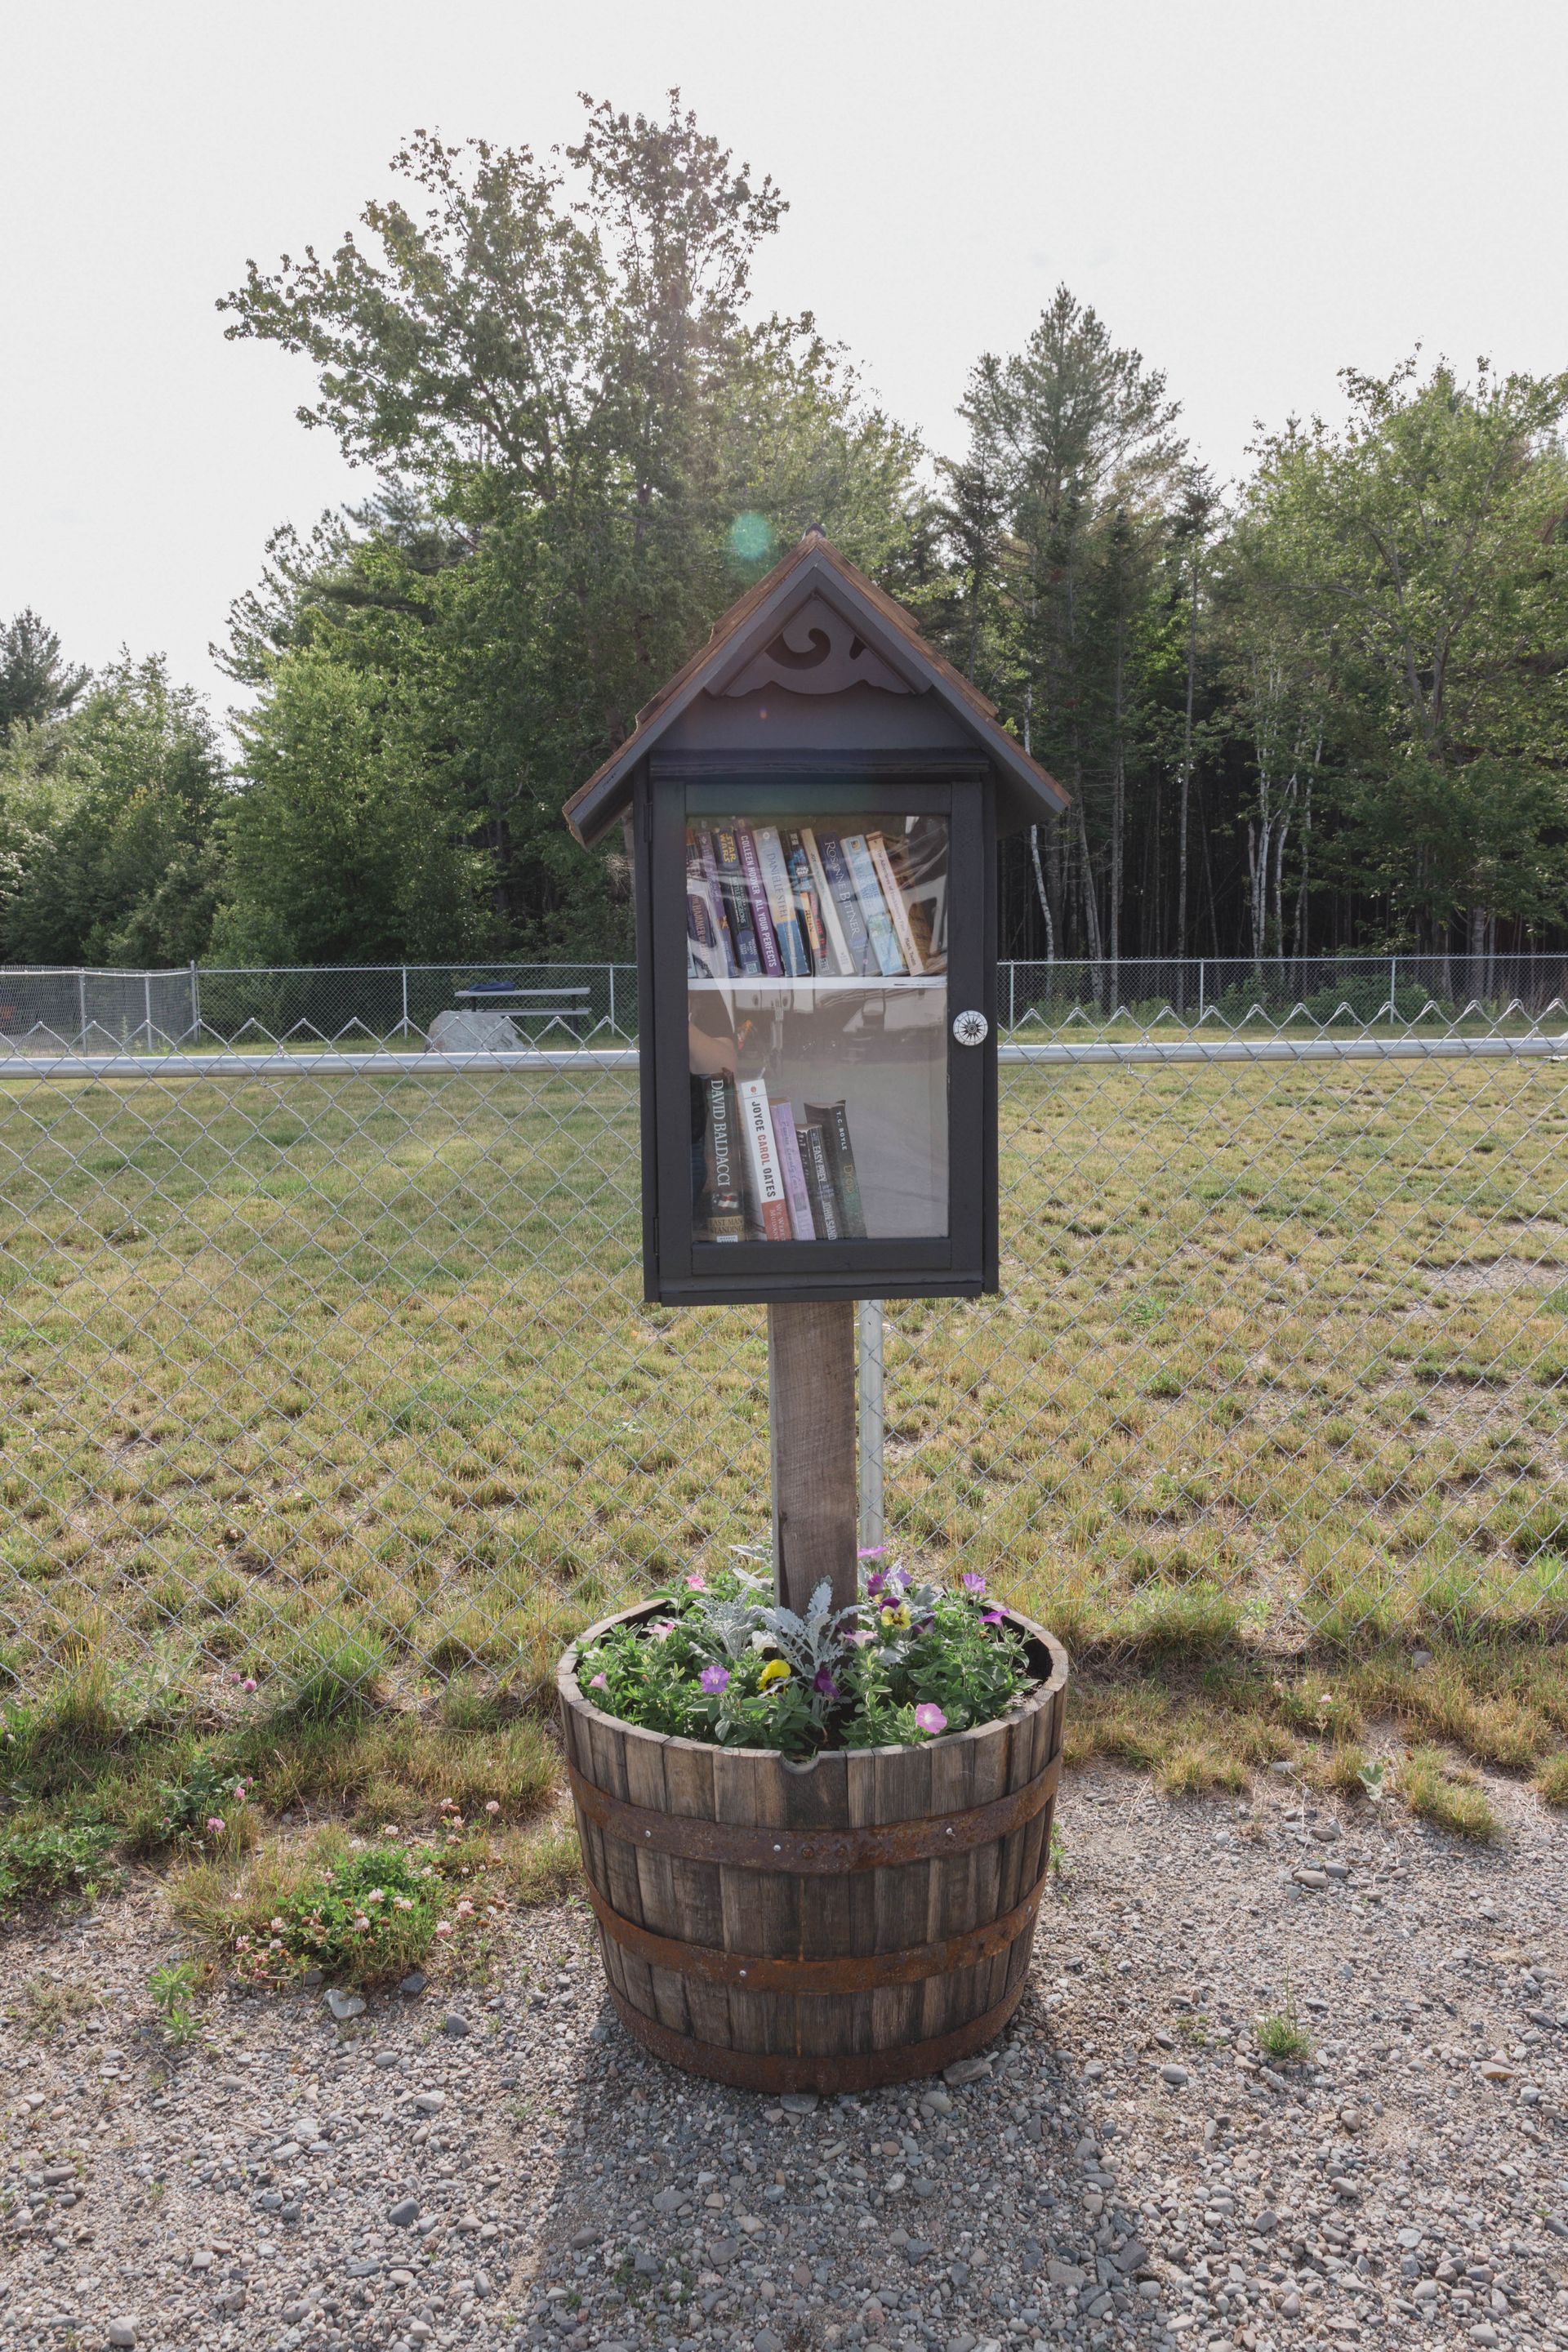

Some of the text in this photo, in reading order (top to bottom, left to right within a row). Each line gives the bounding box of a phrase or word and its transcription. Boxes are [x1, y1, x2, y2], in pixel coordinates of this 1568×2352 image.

[719, 833, 731, 863] WARS
[725, 833, 737, 862] STAR
[767, 853, 788, 918] DANIELLE STEEL
[825, 842, 846, 890] ROSANNE
[840, 892, 860, 939] BITTNER
[741, 835, 777, 968] COLLEEN HOOVER ALL YOUR PERFECTS
[880, 858, 891, 885] Adventures
[908, 951, 916, 965] Twain
[693, 905, 706, 936] HAMMER
[710, 1080, 731, 1187] DAVID BALDACCI
[839, 1129, 848, 1151] BOYLE
[751, 1101, 777, 1198] JOYCE CAROL OATES
[813, 1145, 823, 1164] EASY
[817, 1165, 827, 1182] PREY
[822, 1201, 833, 1220] JOHN
